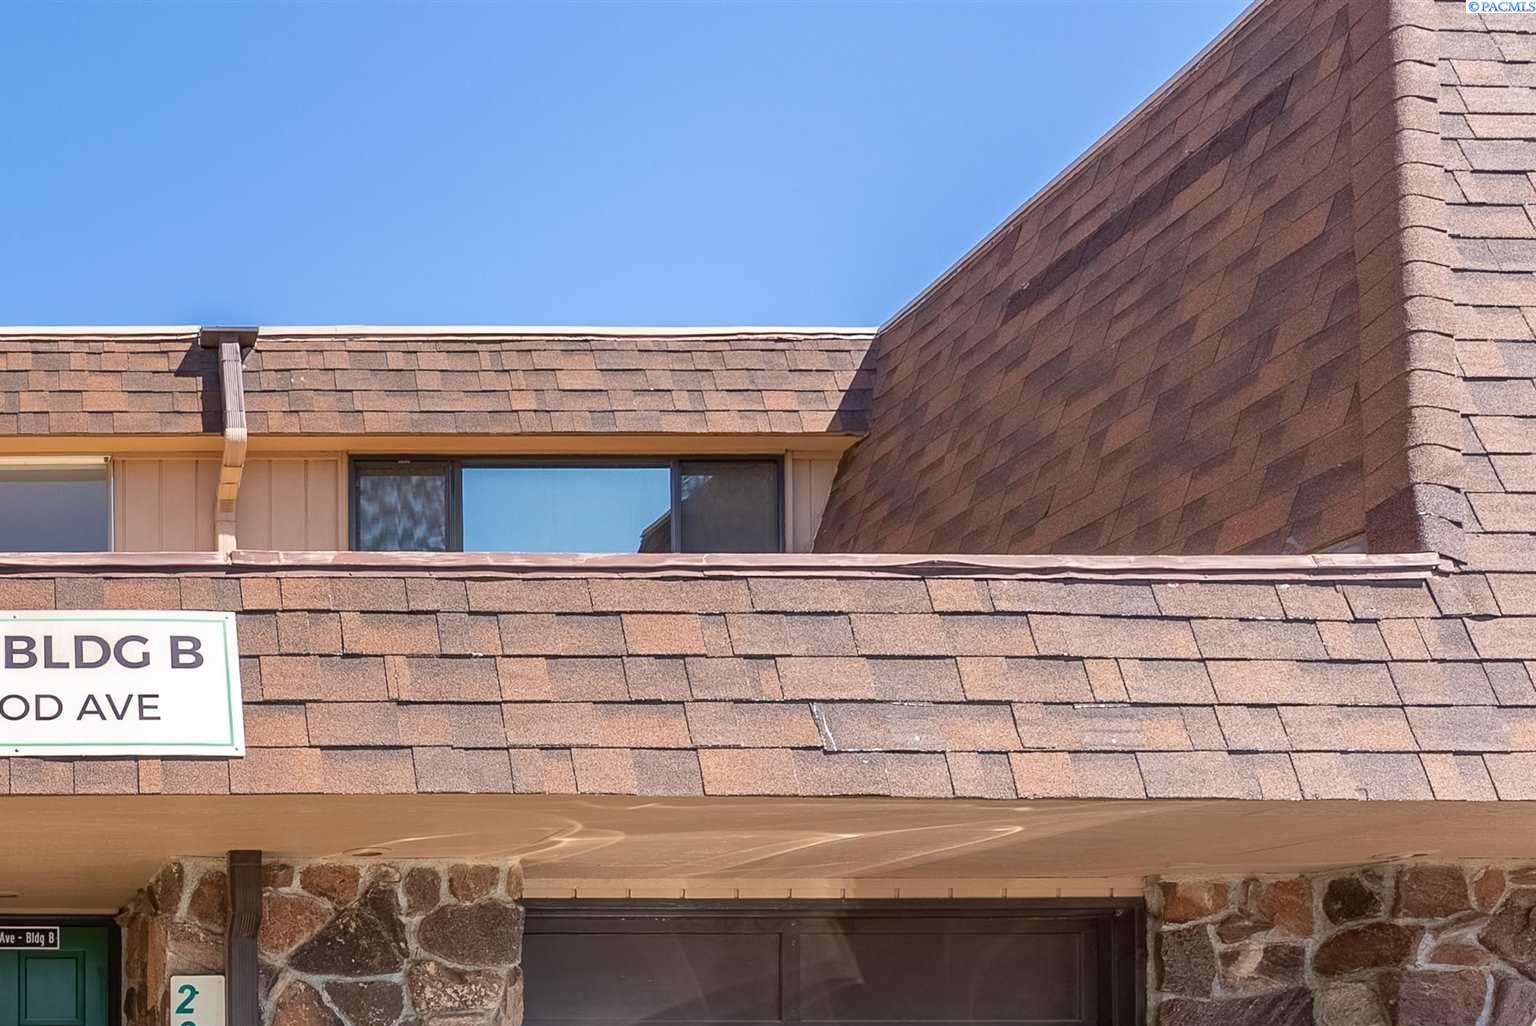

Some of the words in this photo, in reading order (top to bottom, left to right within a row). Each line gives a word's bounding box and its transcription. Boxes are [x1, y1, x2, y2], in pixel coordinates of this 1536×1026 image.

[4, 634, 150, 670] BLDG
[171, 634, 204, 669] B
[76, 694, 161, 721] AVE
[0, 932, 15, 944] Ave
[26, 932, 45, 947] Bldg
[49, 932, 55, 944] B
